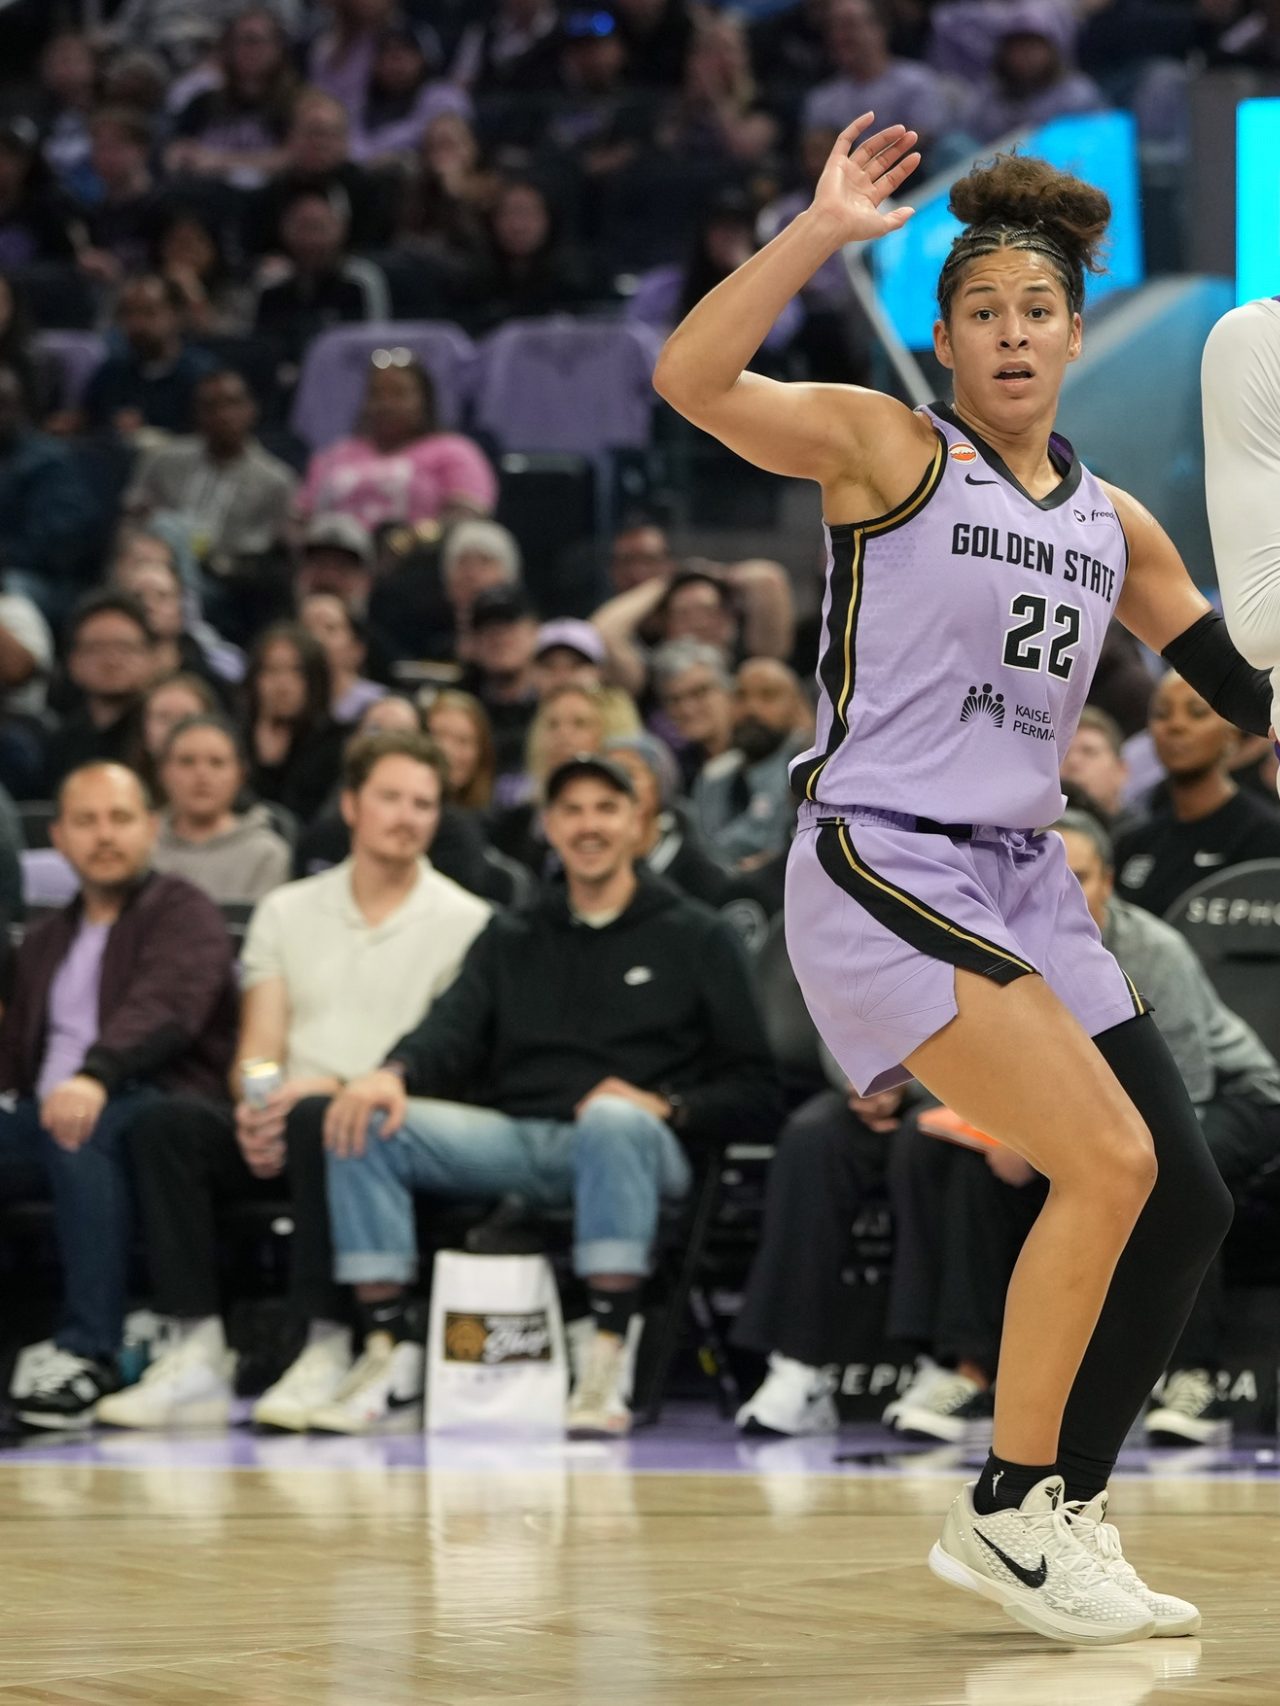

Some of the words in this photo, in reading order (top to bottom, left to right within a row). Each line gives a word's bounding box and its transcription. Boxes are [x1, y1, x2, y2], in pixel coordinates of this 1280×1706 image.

[951, 522, 1055, 576] GOLDEN
[1063, 549, 1116, 603] STATE
[1001, 591, 1082, 683] 22
[1016, 703, 1052, 725] KAISE
